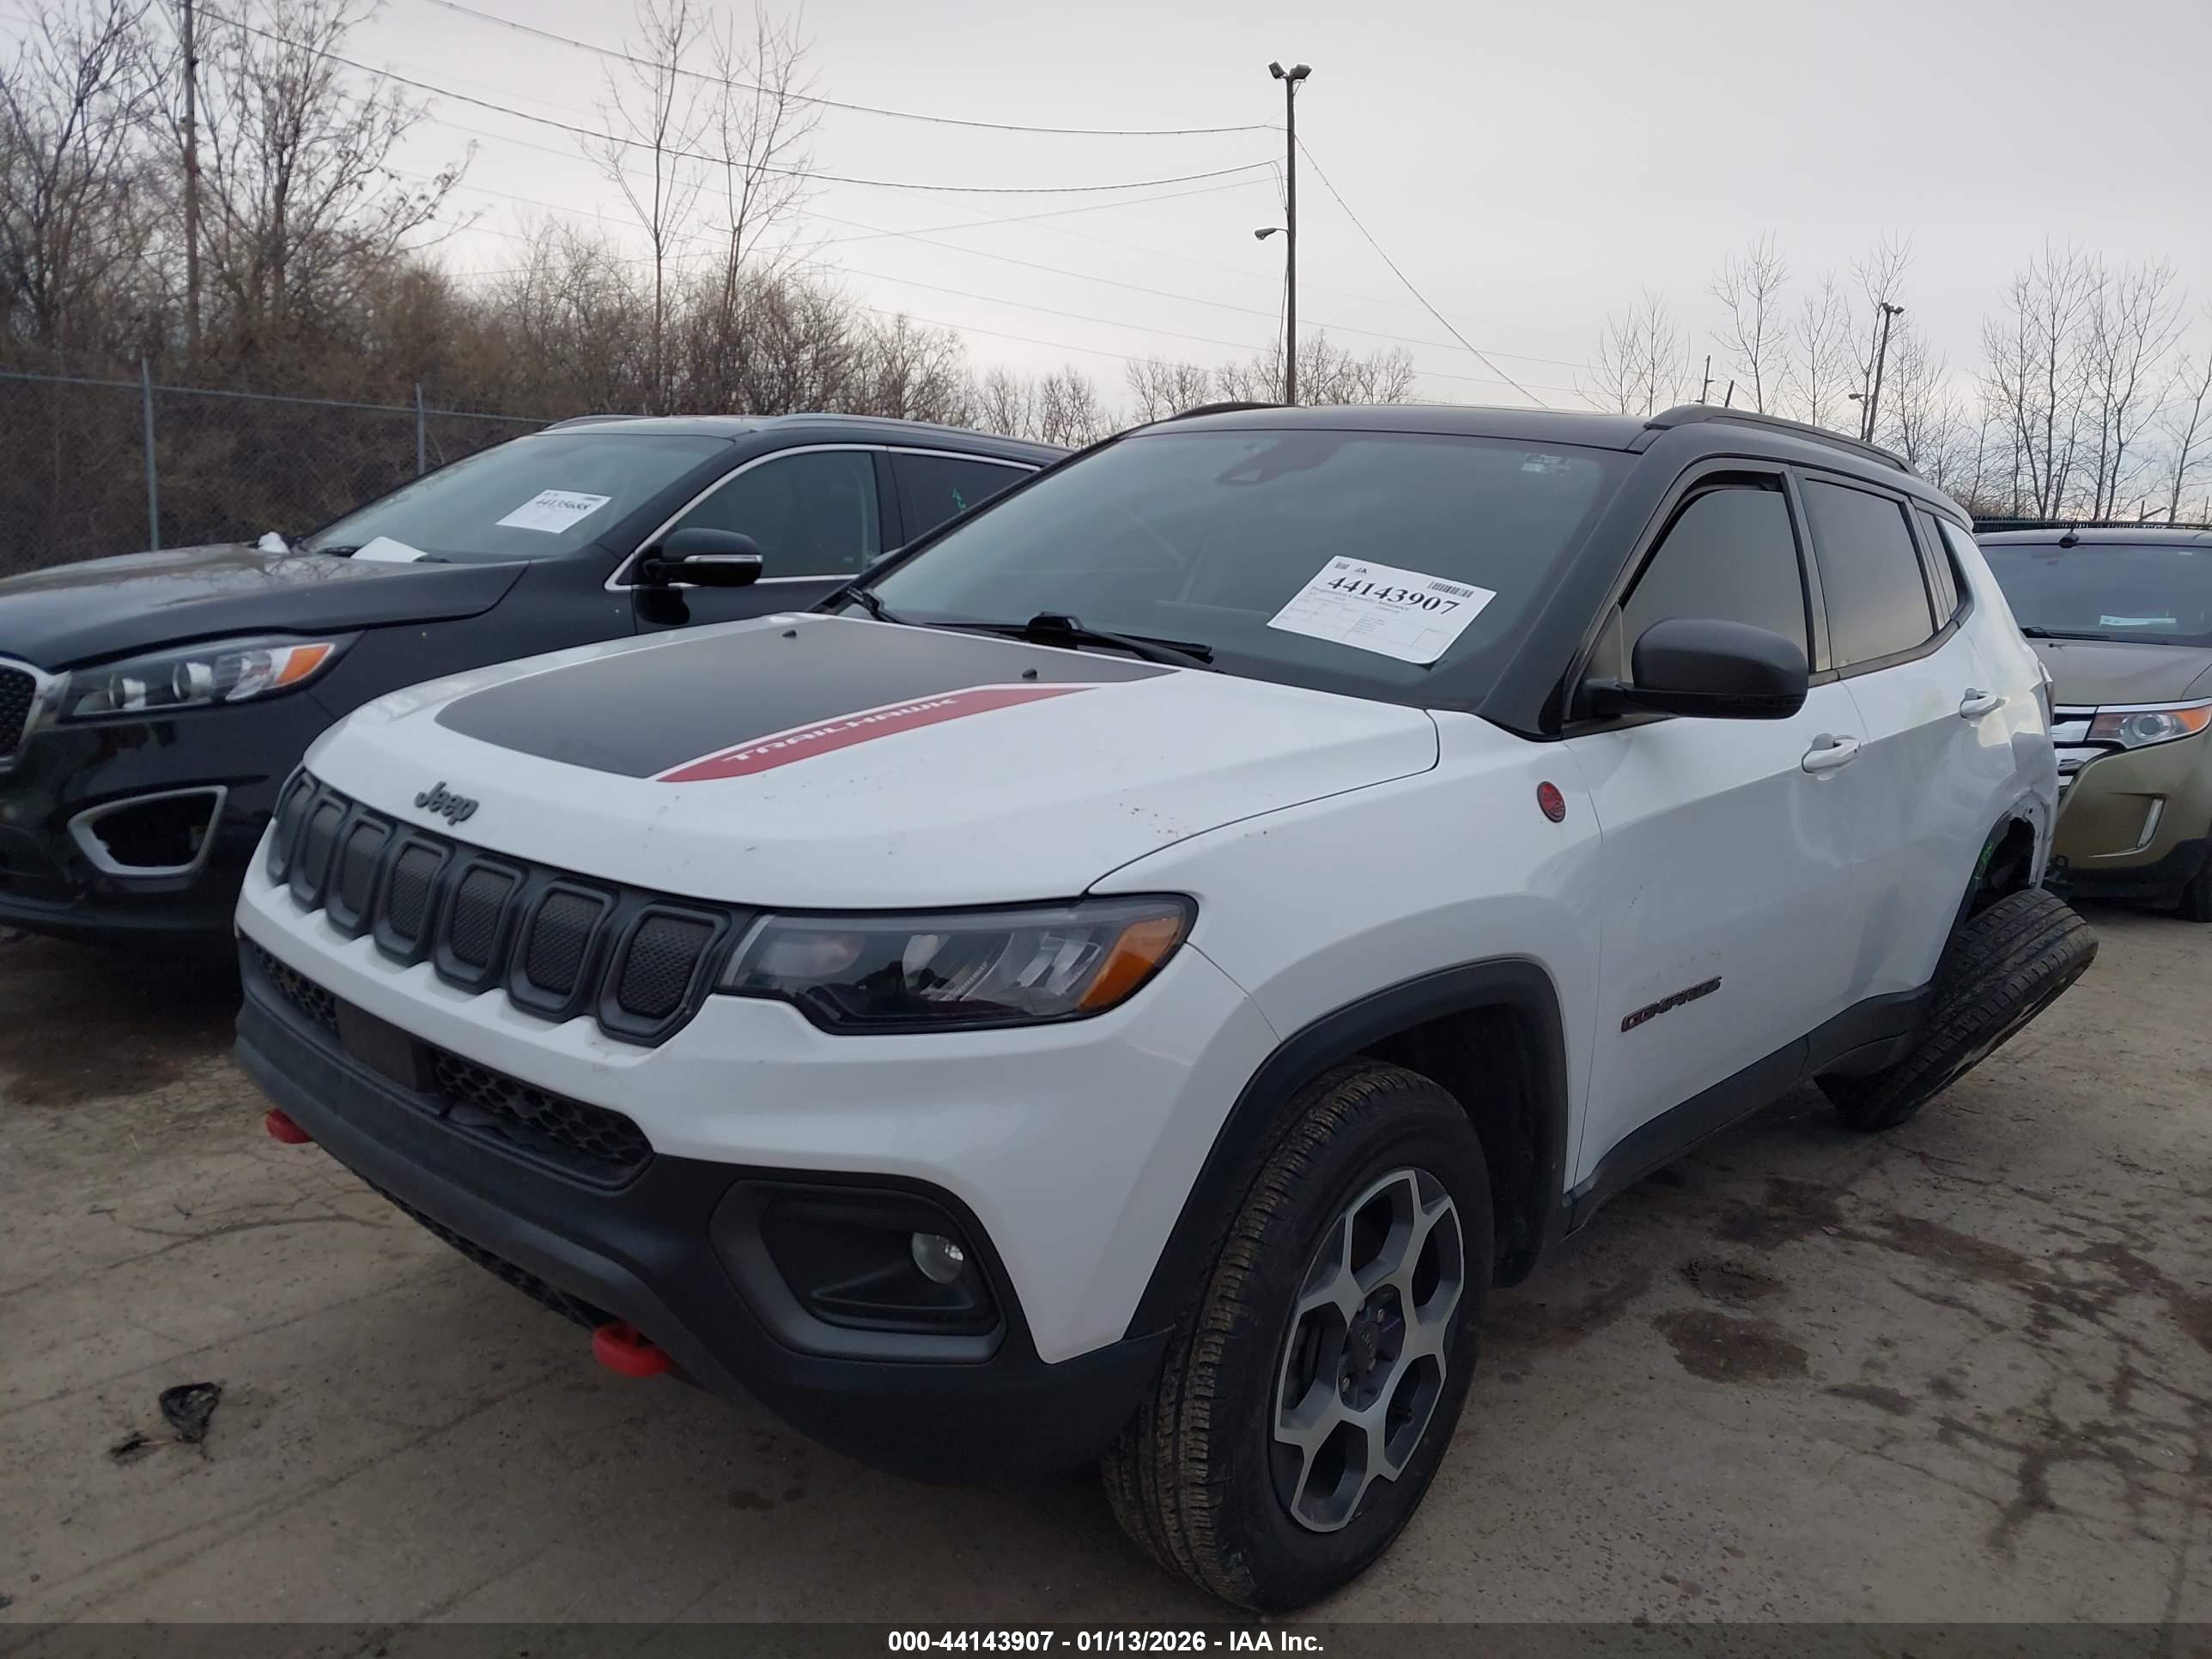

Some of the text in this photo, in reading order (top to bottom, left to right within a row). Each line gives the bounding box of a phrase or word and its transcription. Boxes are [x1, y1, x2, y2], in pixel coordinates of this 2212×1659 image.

[1328, 576, 1461, 615] 44143907
[723, 696, 958, 763] TRAILHAWK
[414, 781, 479, 826] Jeep
